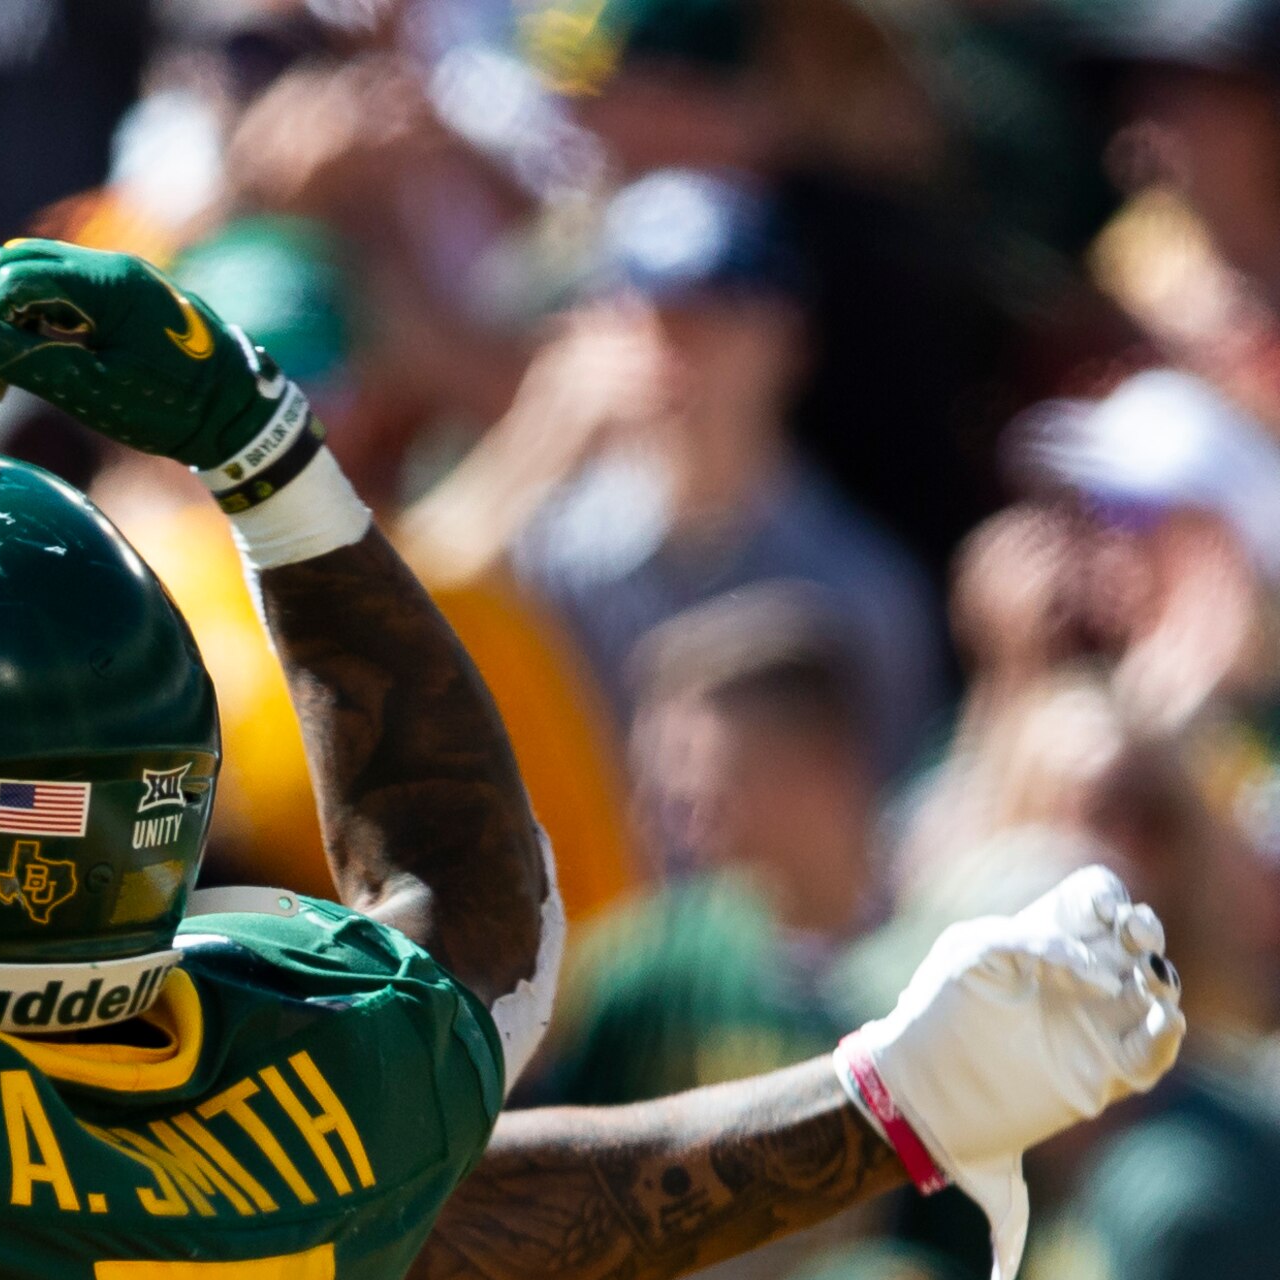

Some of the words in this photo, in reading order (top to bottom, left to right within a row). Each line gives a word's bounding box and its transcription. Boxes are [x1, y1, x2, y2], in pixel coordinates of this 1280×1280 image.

[132, 813, 184, 850] UNITY
[23, 864, 57, 904] BU
[0, 1069, 108, 1213] A.
